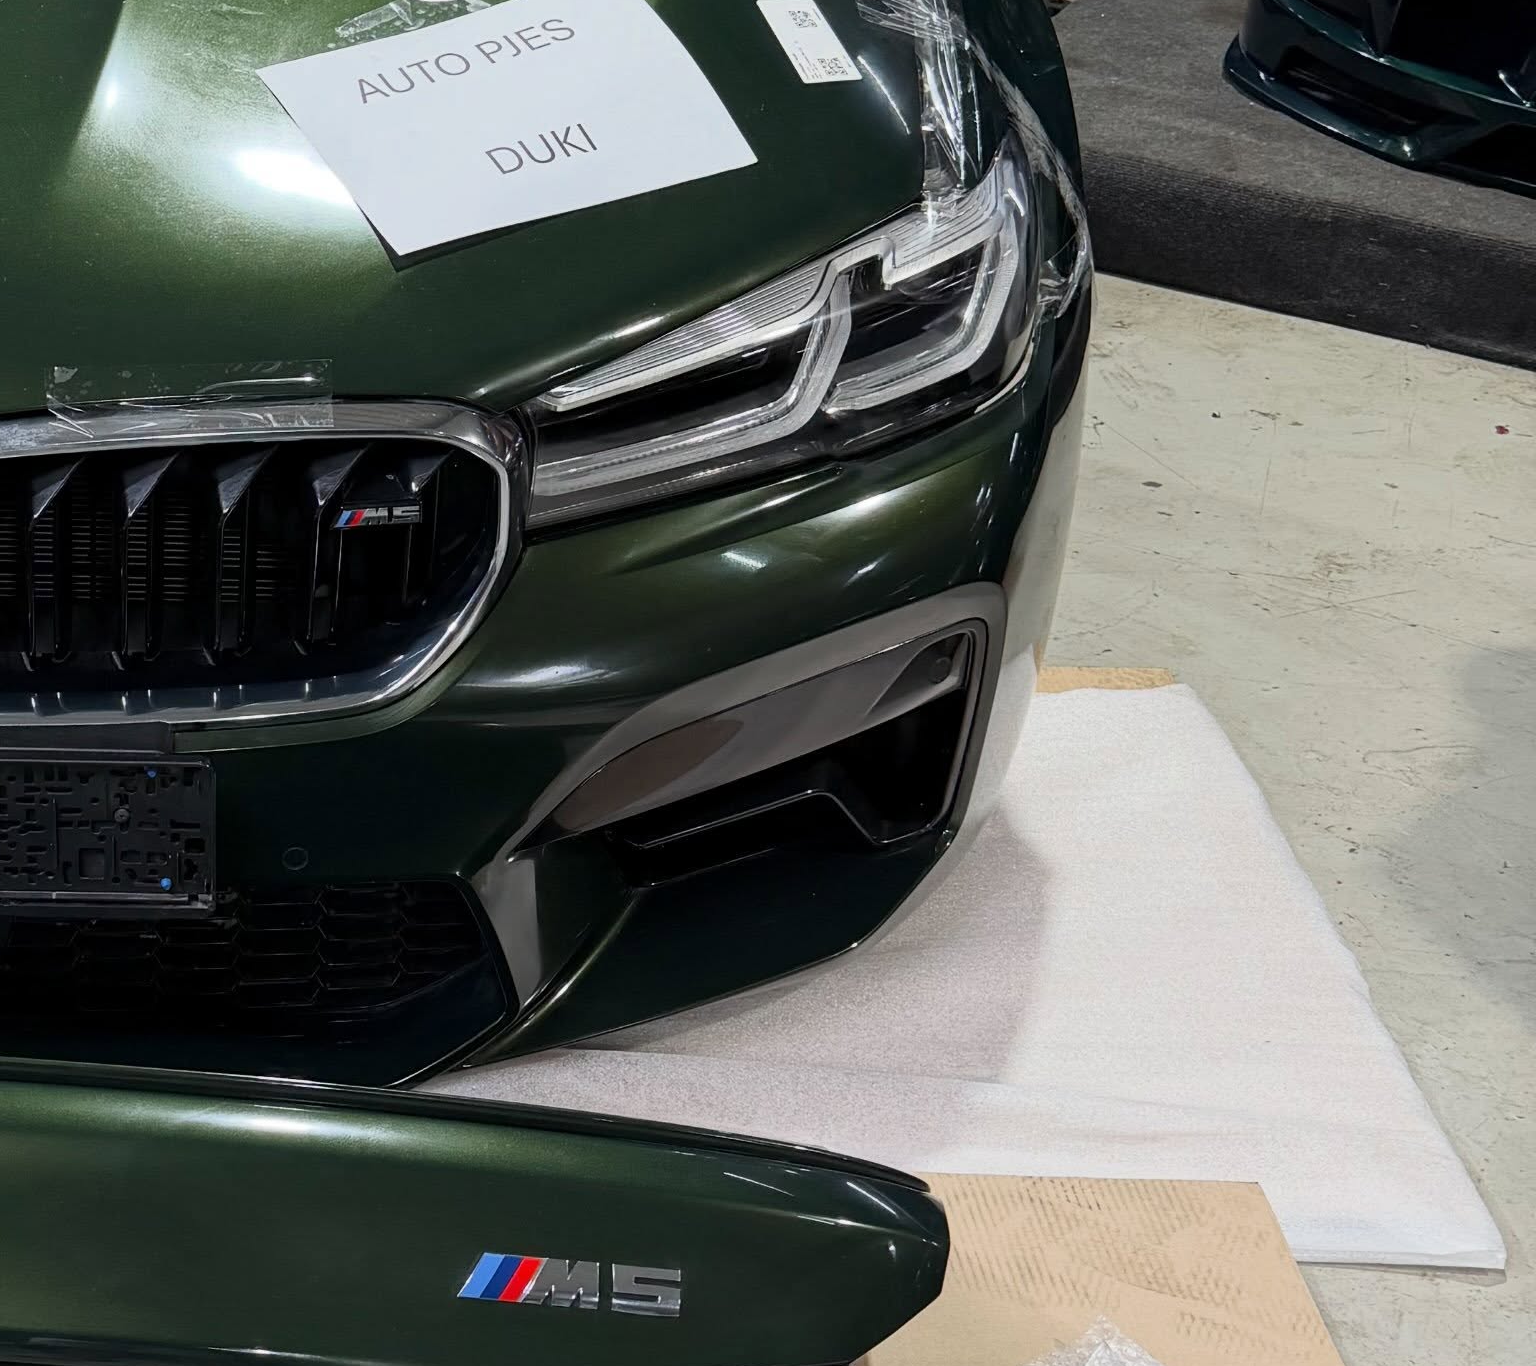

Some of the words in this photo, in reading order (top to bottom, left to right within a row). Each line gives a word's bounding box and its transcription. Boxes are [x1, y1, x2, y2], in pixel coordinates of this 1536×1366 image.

[358, 52, 471, 104] AUTO
[475, 18, 575, 64] PJES
[485, 123, 597, 175] DUKI
[359, 506, 420, 526] M5
[519, 1256, 682, 1317] M5
